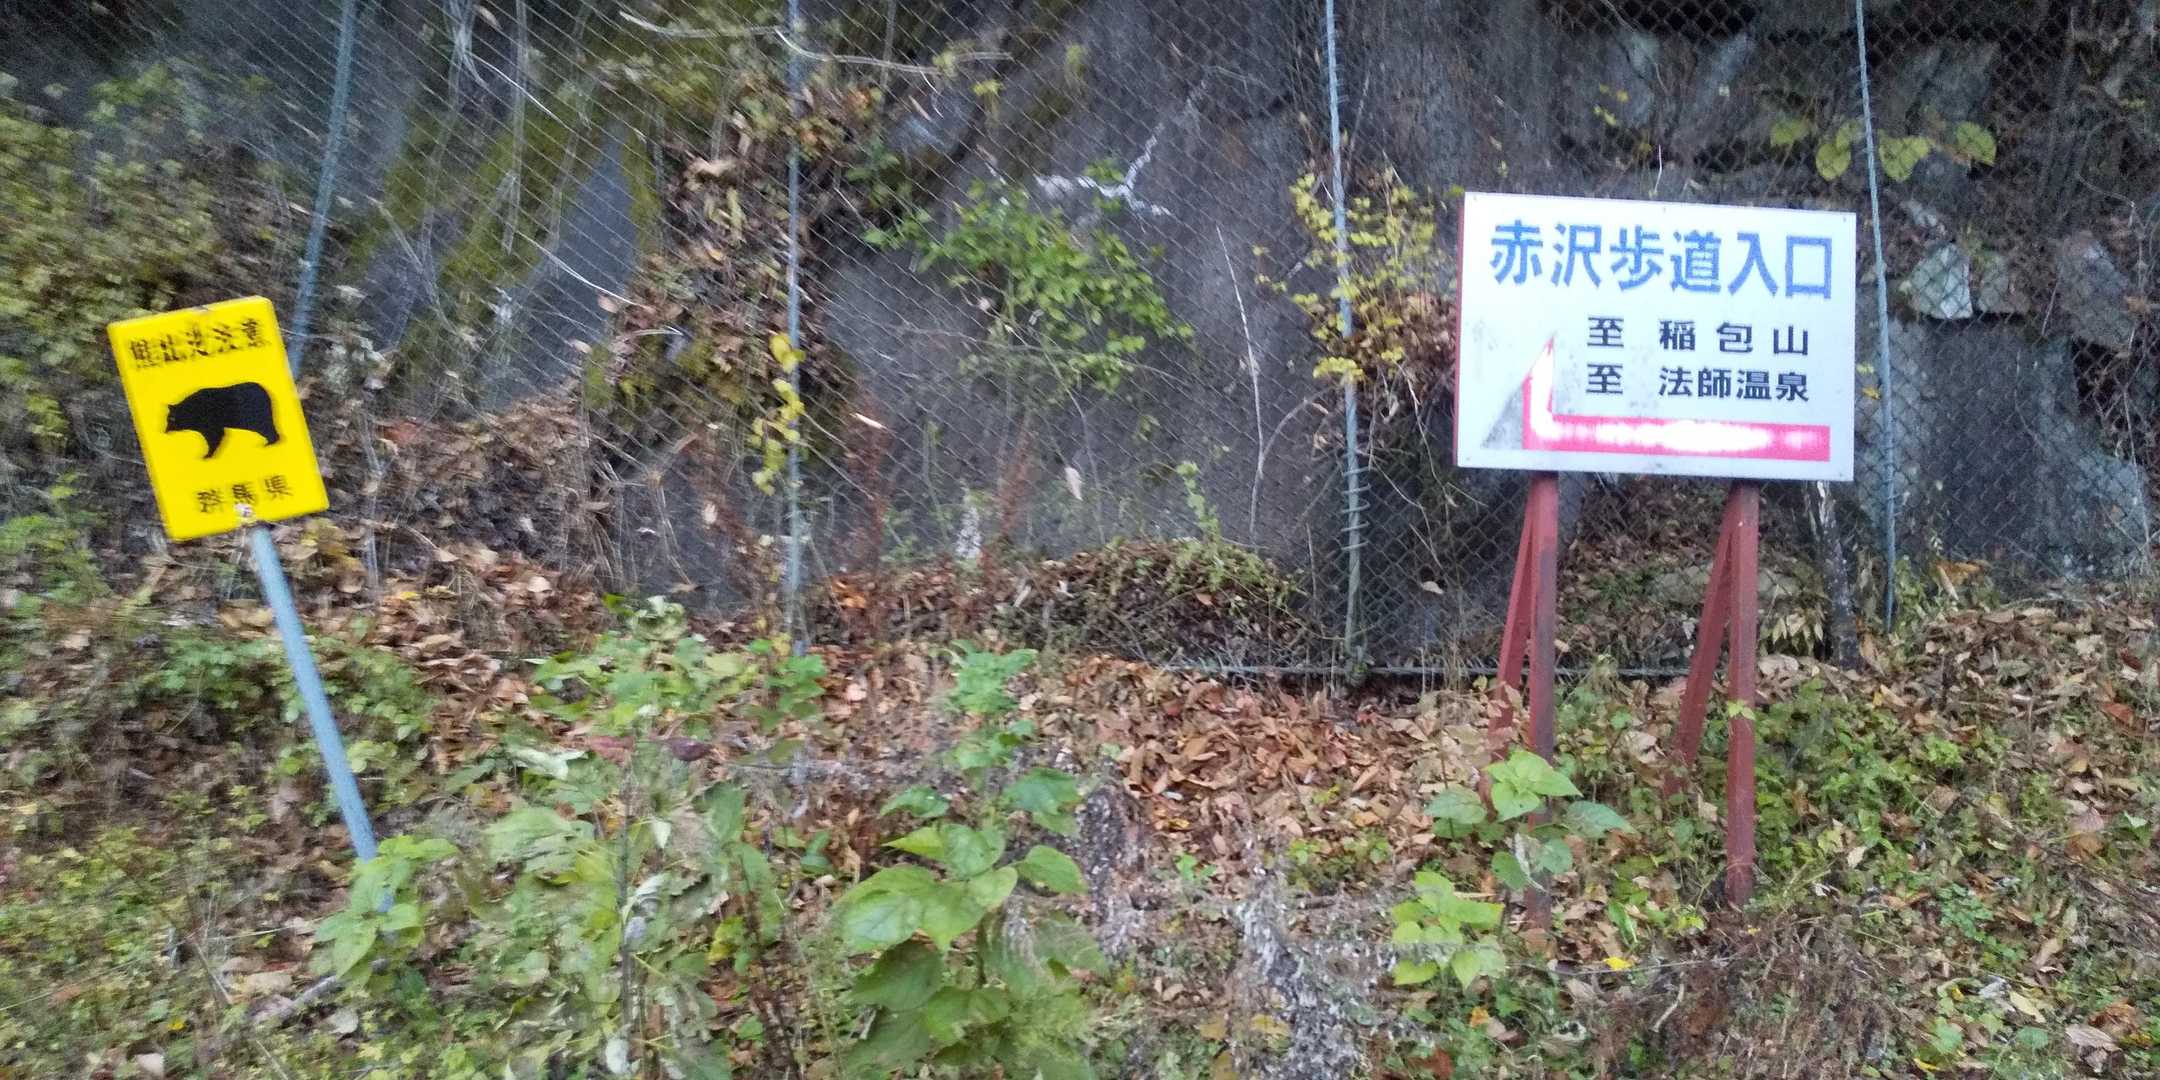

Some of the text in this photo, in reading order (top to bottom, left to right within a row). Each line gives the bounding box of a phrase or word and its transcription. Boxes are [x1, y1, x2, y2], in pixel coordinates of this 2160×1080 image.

[1490, 219, 1833, 299] 赤沢歩道入口
[1587, 316, 1809, 356] 至 稲包山
[1586, 363, 1810, 402] 至 法師温泉
